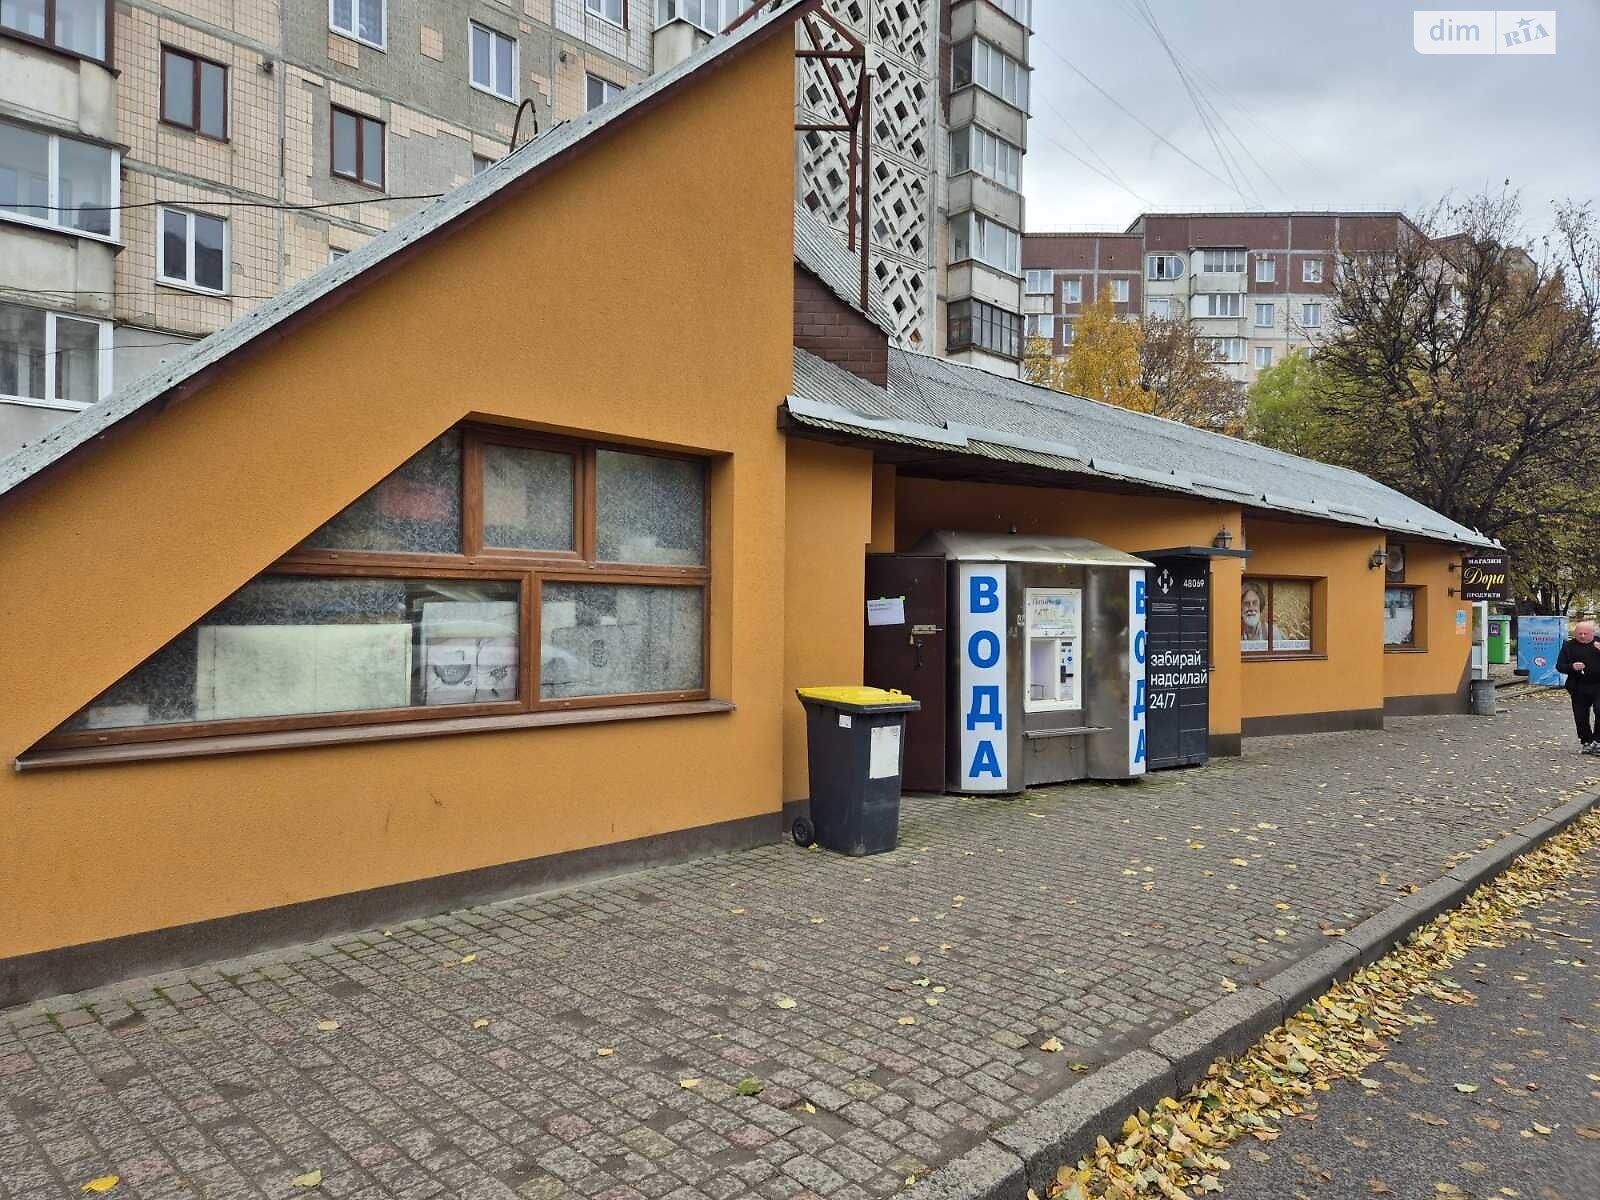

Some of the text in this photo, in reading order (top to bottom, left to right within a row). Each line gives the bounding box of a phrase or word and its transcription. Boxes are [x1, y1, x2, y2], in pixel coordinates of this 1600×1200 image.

[1183, 579, 1205, 588] 48069
[1464, 567, 1505, 590] Дора
[1150, 651, 1202, 669] забирай
[966, 575, 1003, 778] ВОДА
[1150, 669, 1208, 687] надсилай
[1149, 692, 1176, 709] 24/7
